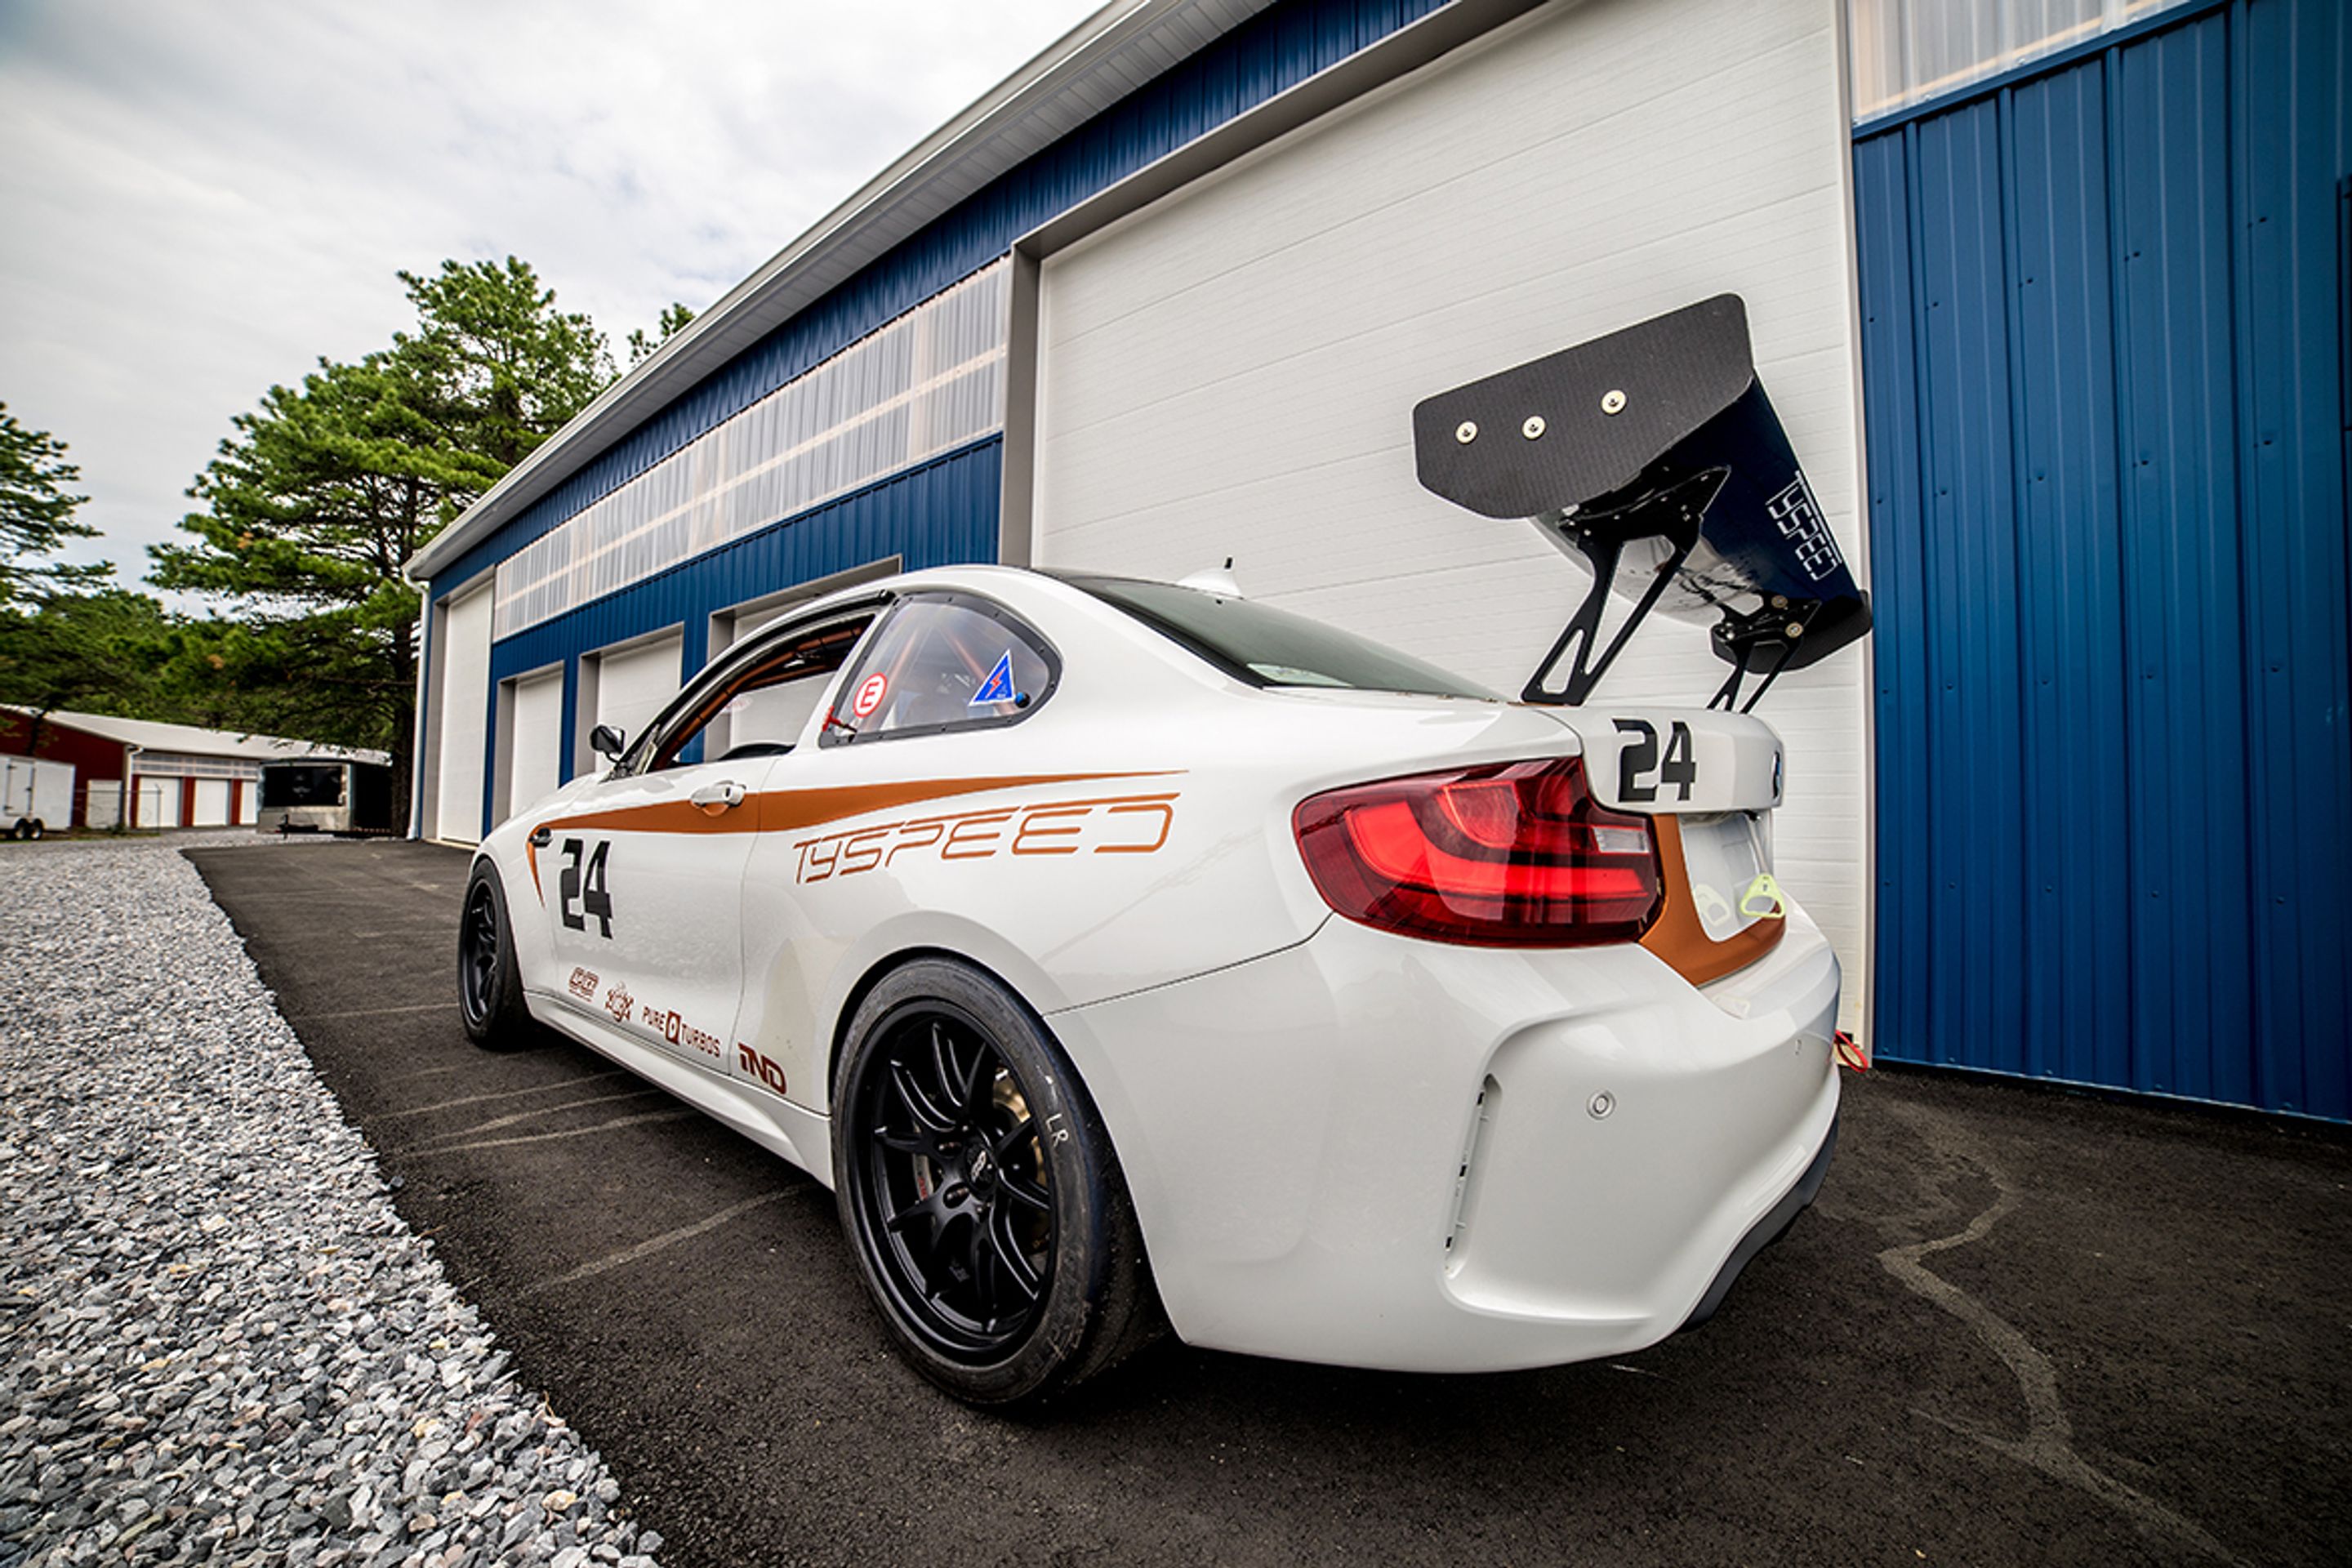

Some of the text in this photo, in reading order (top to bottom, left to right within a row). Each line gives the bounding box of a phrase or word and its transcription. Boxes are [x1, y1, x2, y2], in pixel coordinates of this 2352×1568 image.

[1765, 470, 1842, 581] TYSPEED
[860, 682, 880, 708] E
[1611, 718, 1696, 803] 24
[793, 792, 1181, 884] TYSPEED
[560, 838, 613, 939] 24
[642, 1006, 720, 1058] PURE TURBOS
[1045, 1113, 1070, 1147] LR
